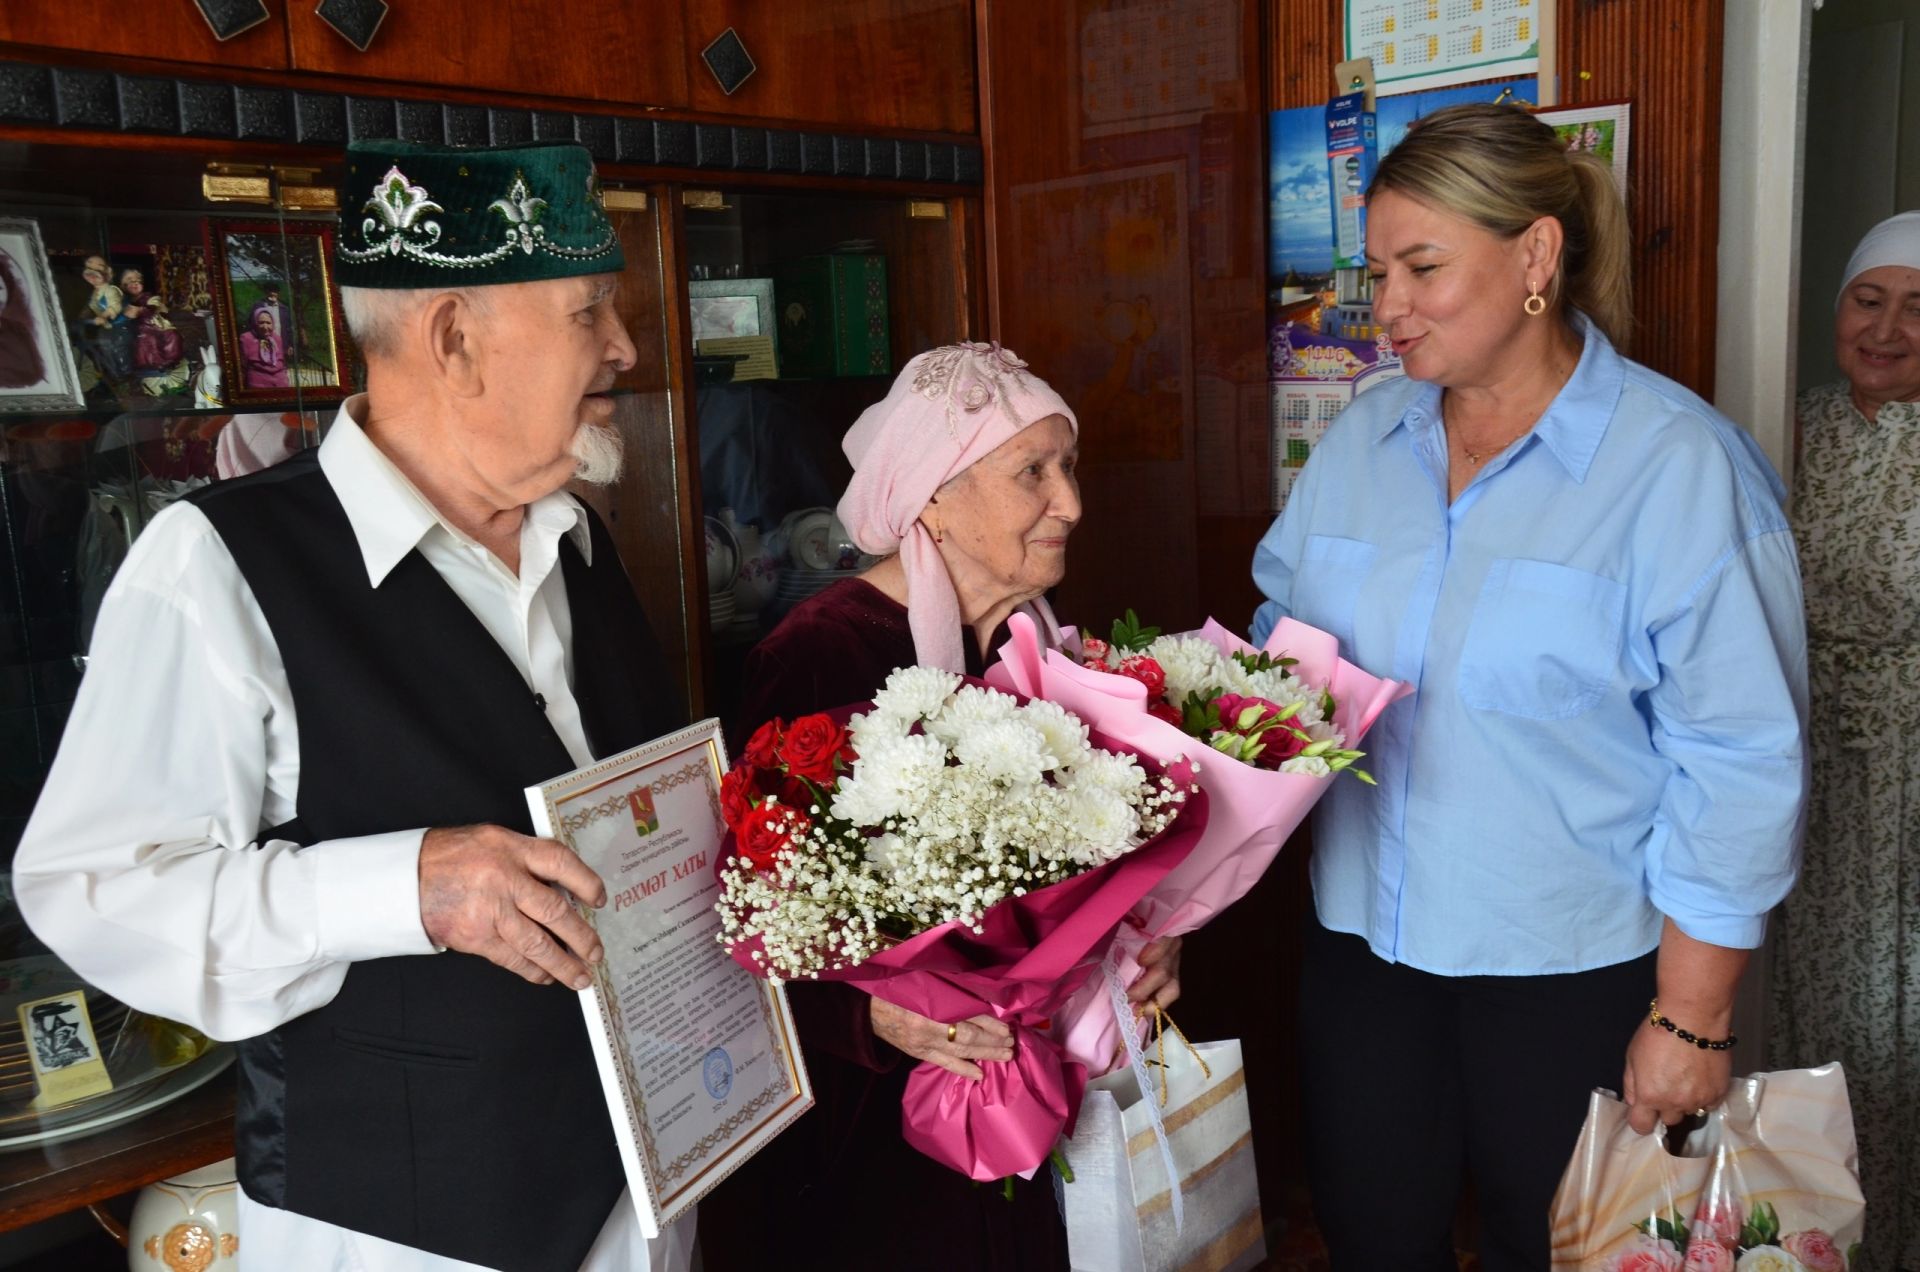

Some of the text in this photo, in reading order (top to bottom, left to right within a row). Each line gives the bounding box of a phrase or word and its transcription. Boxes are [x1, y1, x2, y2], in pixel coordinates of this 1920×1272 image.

[1336, 116, 1358, 128] VOLPE
[1305, 344, 1345, 363] 1446
[614, 870, 668, 912] РӘХМӘТ
[672, 850, 707, 882] ХАТЫ
